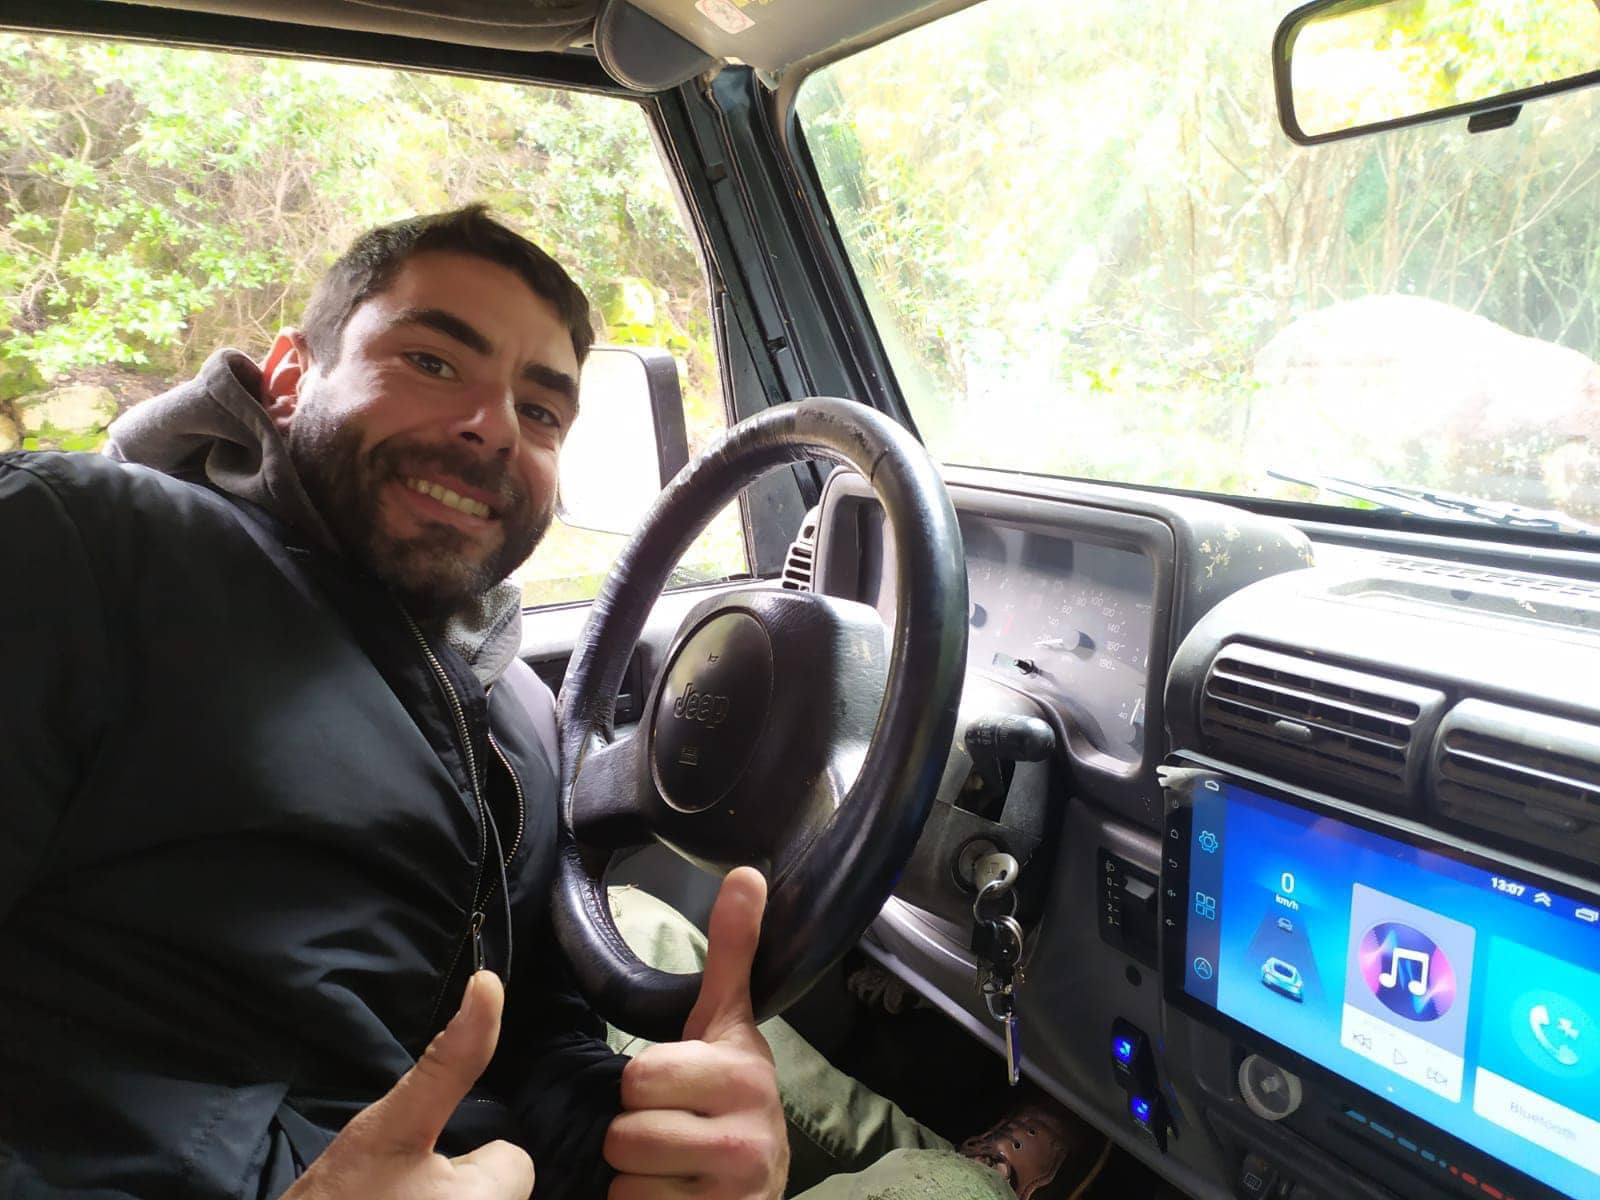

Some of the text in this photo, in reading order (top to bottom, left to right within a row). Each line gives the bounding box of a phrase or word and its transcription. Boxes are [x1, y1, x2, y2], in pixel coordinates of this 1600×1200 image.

[1107, 623, 1120, 633] 140
[674, 682, 729, 729] Jeep
[1281, 872, 1295, 893] 0
[1275, 894, 1299, 911] km/h
